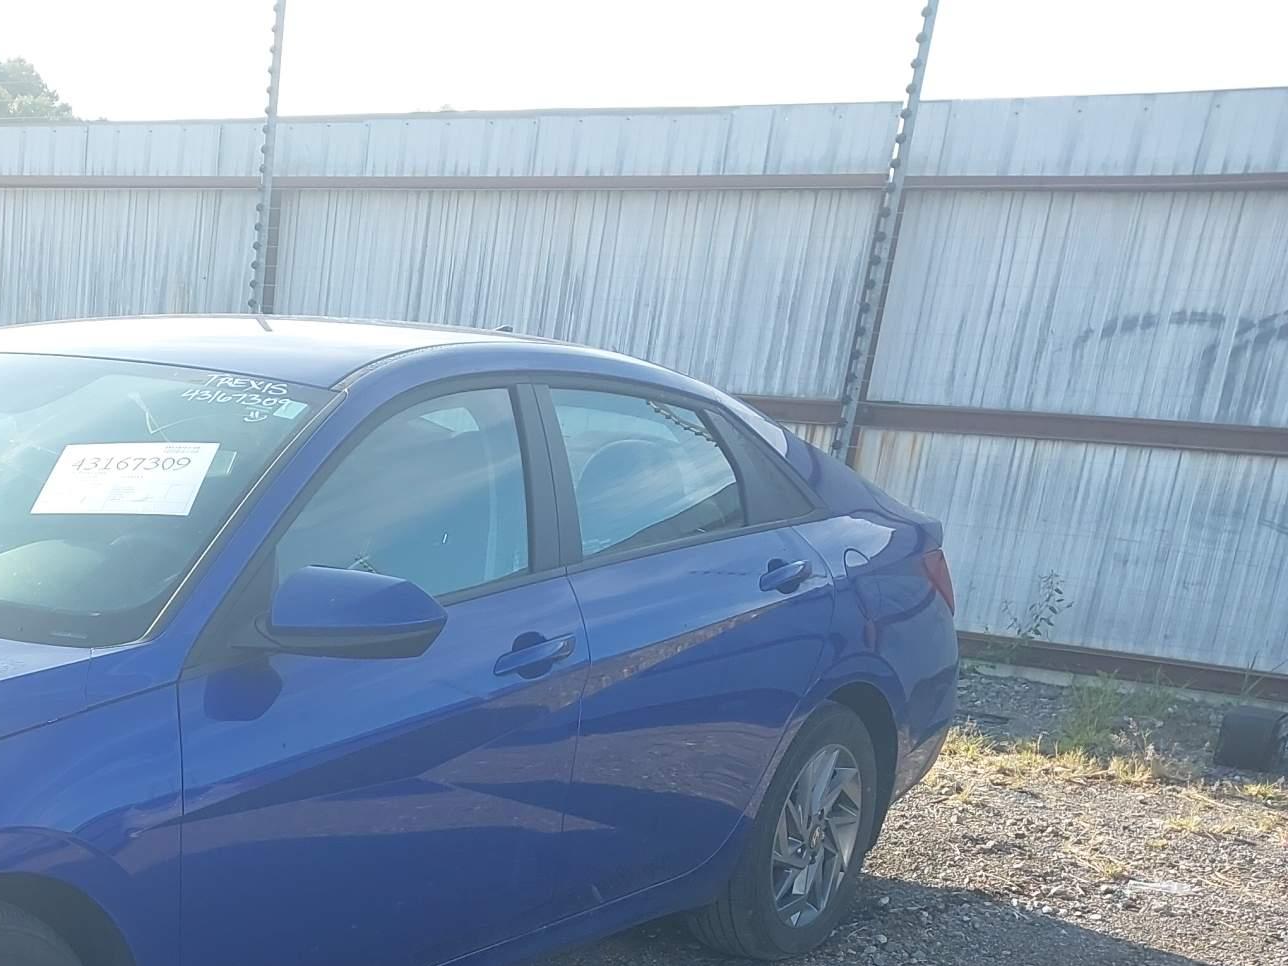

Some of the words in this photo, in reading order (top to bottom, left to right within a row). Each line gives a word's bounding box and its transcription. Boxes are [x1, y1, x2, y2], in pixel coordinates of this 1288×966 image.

[204, 374, 288, 395] TREXIS
[181, 388, 292, 411] 43167309
[71, 456, 192, 471] 43167309
